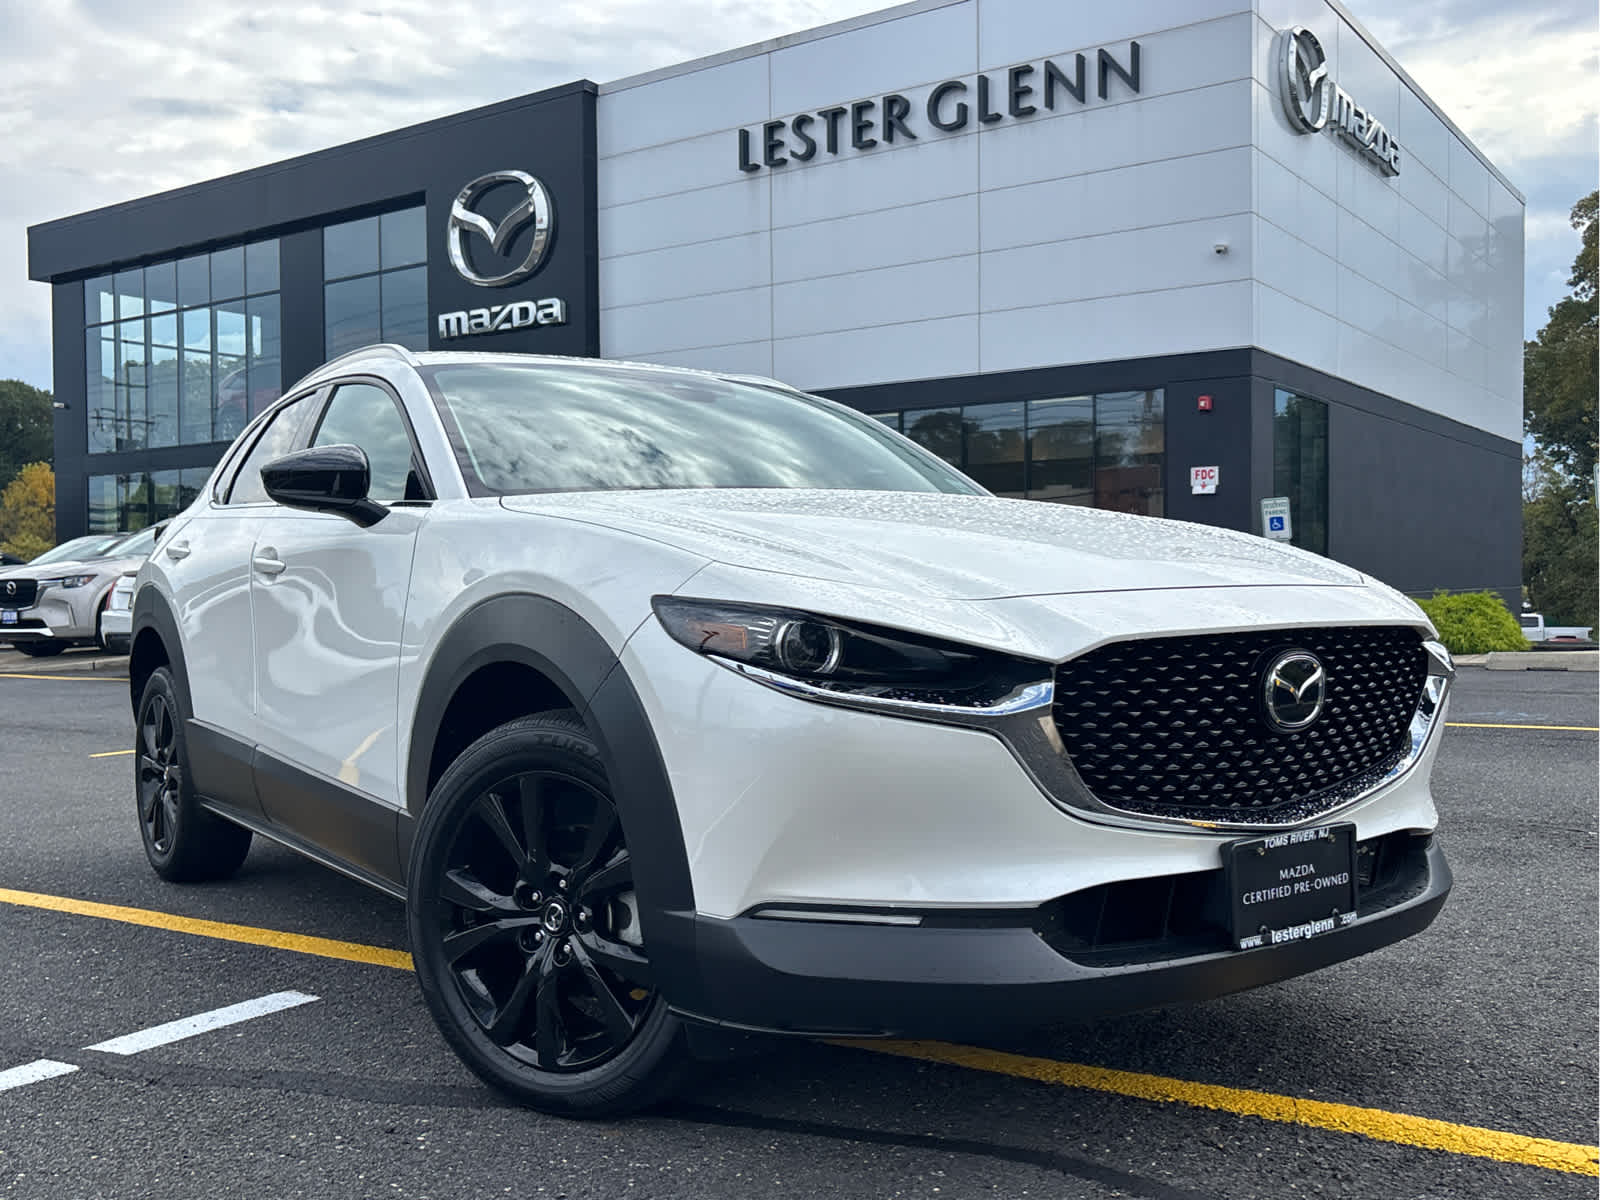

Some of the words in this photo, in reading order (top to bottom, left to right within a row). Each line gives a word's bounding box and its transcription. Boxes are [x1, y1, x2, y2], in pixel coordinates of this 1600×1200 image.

[738, 93, 918, 172] LESTER
[926, 40, 1141, 133] GLENN
[438, 297, 566, 339] mazda
[1194, 469, 1215, 480] FDC
[1264, 836, 1288, 849] TOMS
[1318, 828, 1330, 838] NJ
[1279, 863, 1316, 880] MAZDA
[1242, 886, 1291, 905] CERTIFIED
[1294, 872, 1349, 894] PRE-OWNED
[1271, 918, 1335, 944] lesterglenn
